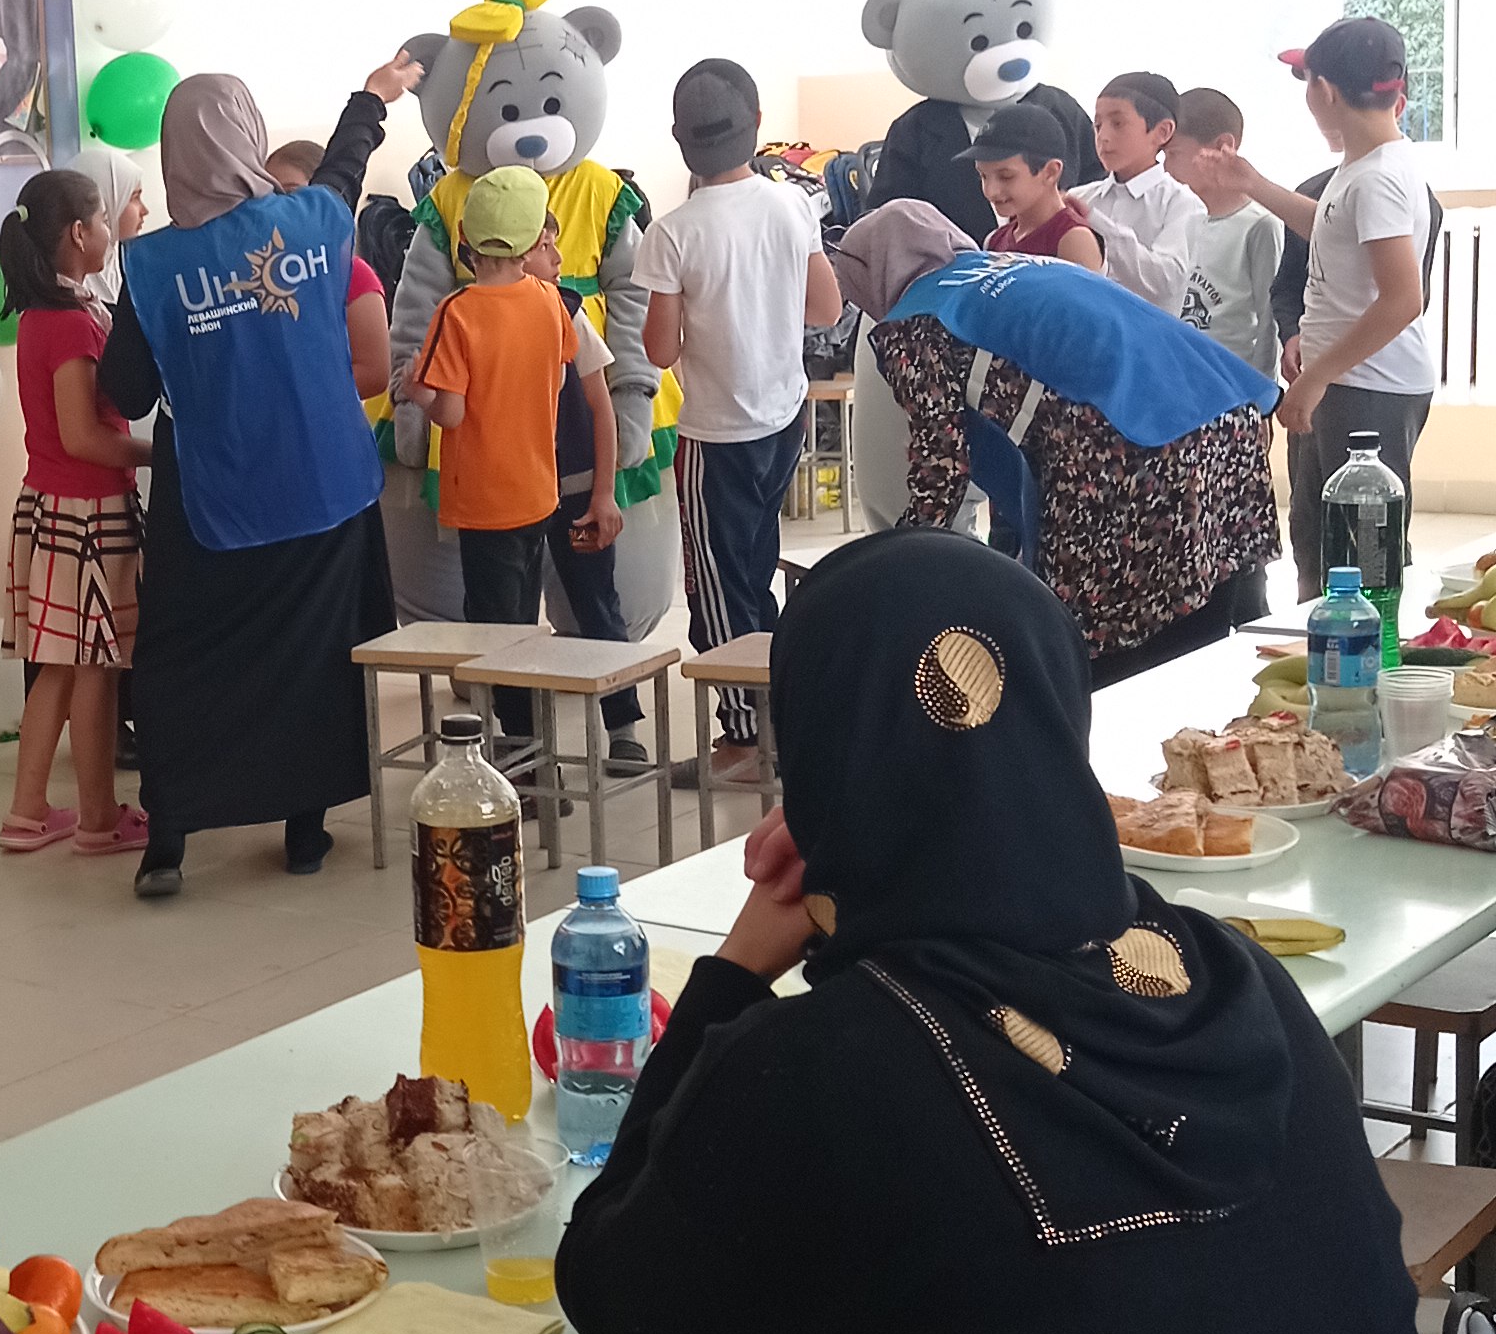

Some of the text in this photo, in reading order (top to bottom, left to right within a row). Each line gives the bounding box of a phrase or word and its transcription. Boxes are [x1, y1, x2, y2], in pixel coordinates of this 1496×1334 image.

[1189, 271, 1223, 306] RVATION
[187, 297, 258, 323] ЛЕВАШИНСКИЙ
[189, 320, 222, 336] РАЙОН
